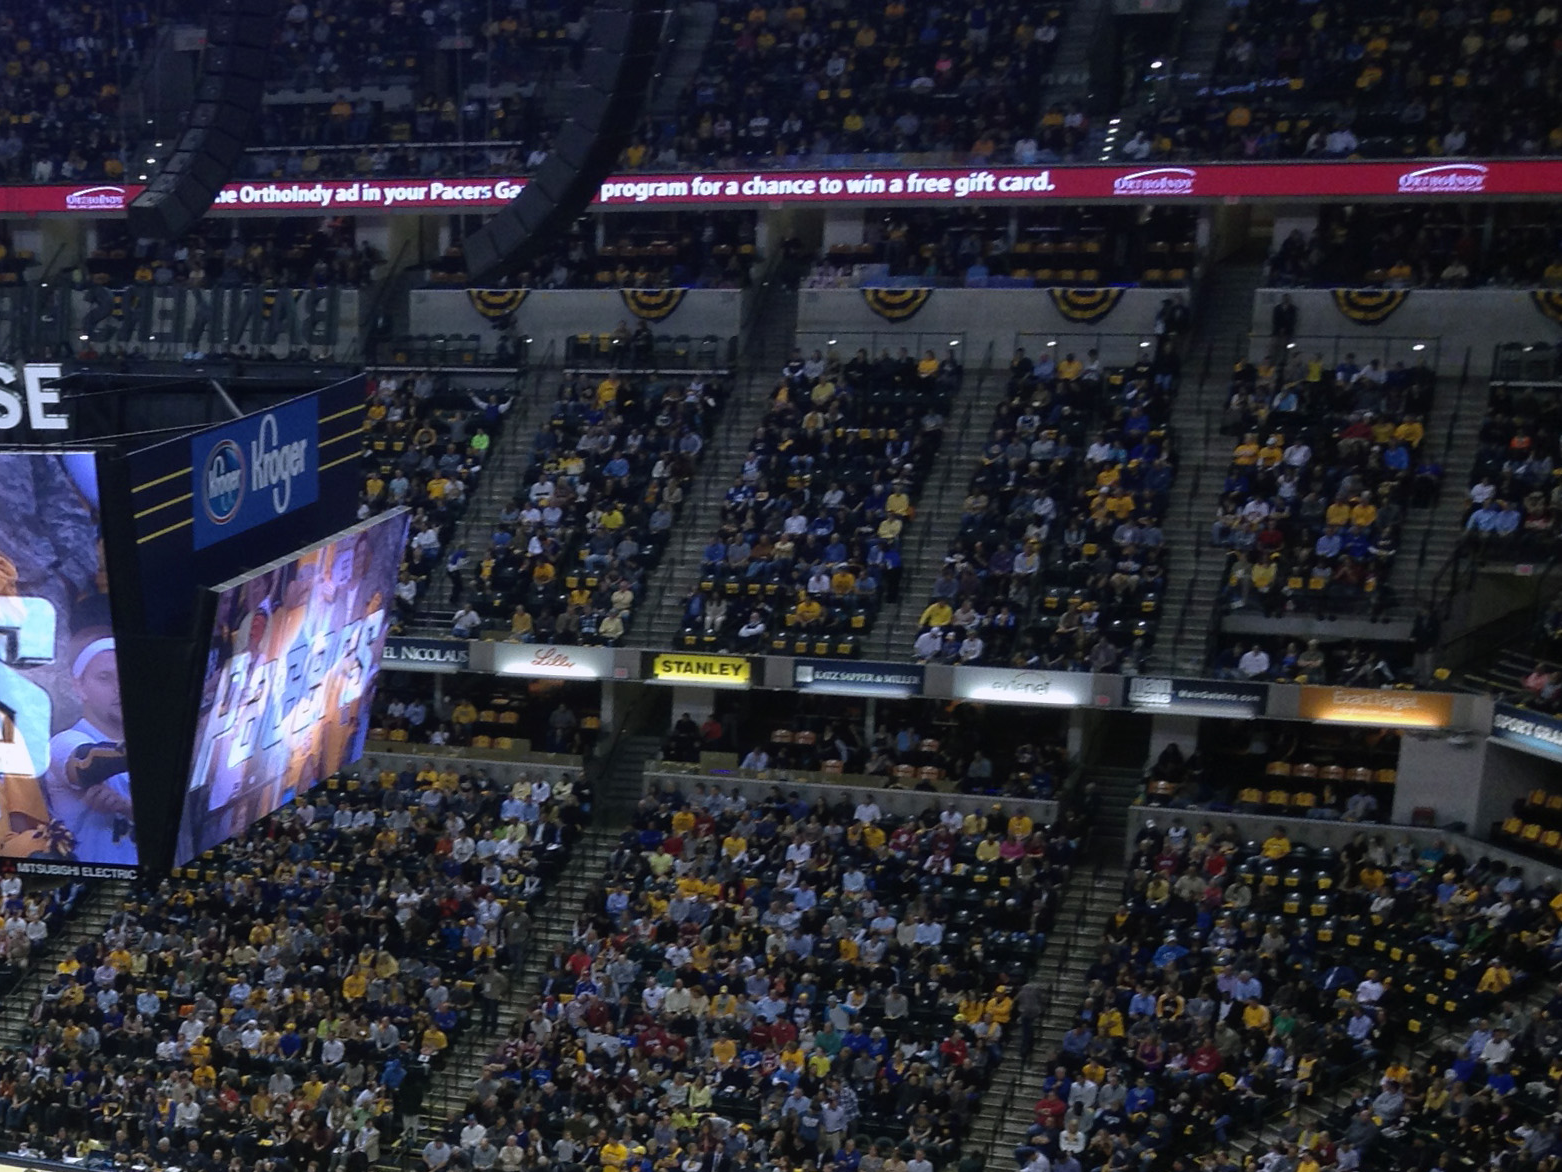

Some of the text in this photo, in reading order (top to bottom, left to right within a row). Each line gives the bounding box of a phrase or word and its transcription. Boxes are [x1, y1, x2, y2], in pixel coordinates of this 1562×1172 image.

[335, 183, 359, 201] ad
[363, 183, 380, 200] in
[384, 185, 427, 204] your
[430, 183, 491, 199] Pacers
[600, 182, 688, 201] program
[691, 177, 721, 196] for
[725, 182, 741, 195] a
[742, 176, 815, 195] chance
[819, 177, 842, 194] to
[846, 175, 885, 193] win
[889, 179, 901, 193] a
[906, 173, 950, 192] free
[955, 173, 993, 197] gift
[998, 171, 1055, 192] card.
[251, 414, 308, 513] Kroger
[401, 646, 470, 663] NICOLAUS
[531, 647, 575, 668] Lilly
[661, 660, 742, 677] STANLEY
[17, 863, 137, 881] MITSUBISHI ELECTRIC
